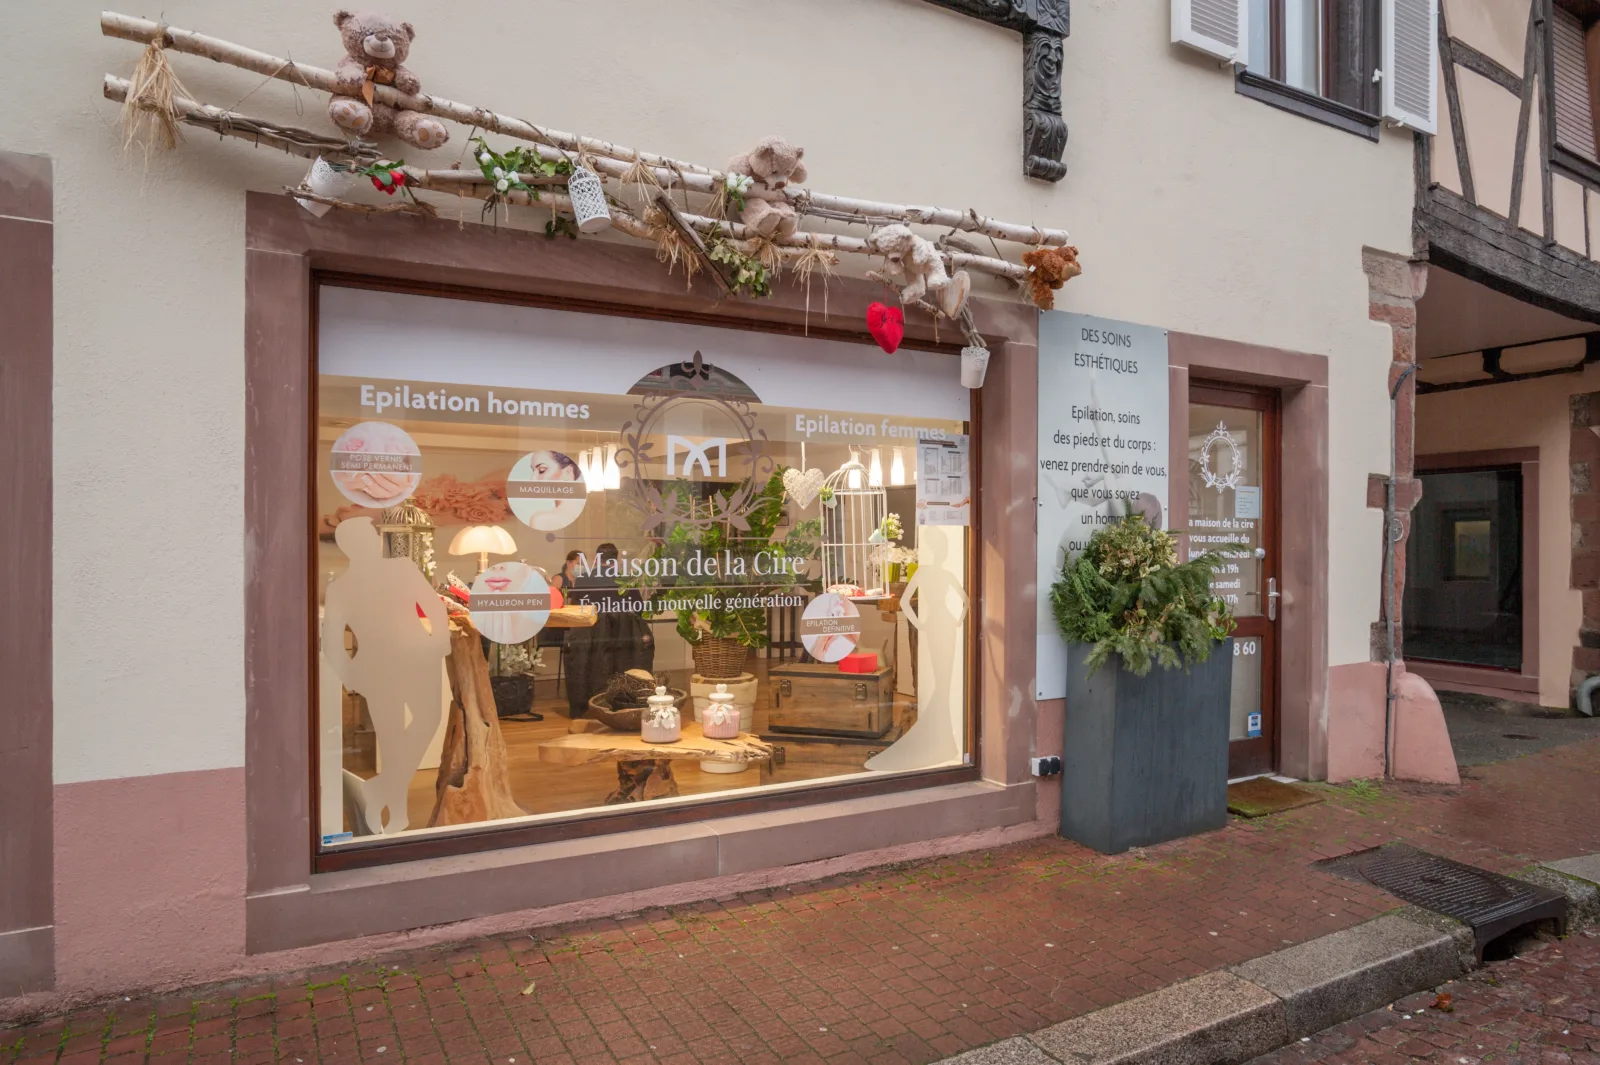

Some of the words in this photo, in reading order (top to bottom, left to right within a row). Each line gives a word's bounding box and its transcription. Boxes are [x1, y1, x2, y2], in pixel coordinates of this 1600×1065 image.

[1081, 328, 1100, 343] DES
[1101, 332, 1131, 348] SOINS
[1074, 353, 1138, 374] ESTHÉTIQUES
[360, 384, 480, 413] Epilation
[488, 391, 590, 419] hommes
[1071, 405, 1116, 424] Epilation,
[1117, 412, 1141, 425] soins
[795, 414, 876, 438] Epilation
[880, 419, 946, 440] femmes
[1053, 430, 1071, 444] des
[1073, 433, 1099, 448] pieds
[1101, 437, 1111, 448] et
[1113, 435, 1125, 449] du
[349, 454, 371, 462] POSE
[374, 455, 403, 463] VERNIS
[341, 461, 361, 469] SEMI
[363, 462, 413, 471] PERMANENT
[1040, 459, 1069, 471] venez
[1071, 461, 1109, 475] prendre
[1110, 462, 1130, 474] soin
[1132, 463, 1144, 475] de
[1146, 464, 1167, 477] vous,
[519, 485, 575, 494] MAQUILLAGE
[1071, 488, 1089, 501] que
[1091, 488, 1113, 499] vous
[1081, 514, 1093, 524] un
[1095, 510, 1125, 525] homm
[1195, 518, 1221, 528] maison
[1222, 518, 1231, 528] de
[1232, 519, 1239, 528] la
[1241, 519, 1254, 528] cire
[1208, 534, 1239, 543] accueille
[1241, 534, 1250, 543] du
[1069, 541, 1082, 551] ou
[577, 550, 678, 578] Maison
[686, 550, 718, 576] de
[724, 550, 748, 575] la
[754, 550, 805, 575] Cire
[1227, 563, 1239, 573] 19h
[1215, 579, 1241, 588] samedi
[477, 599, 524, 607] HYALURON
[526, 598, 543, 606] PEN
[579, 595, 653, 614] Épilation
[658, 594, 721, 611] nouvelle
[725, 592, 803, 611] génération
[1227, 594, 1239, 604] 17h
[806, 619, 838, 627] EPILATION
[1242, 641, 1256, 656] 60
